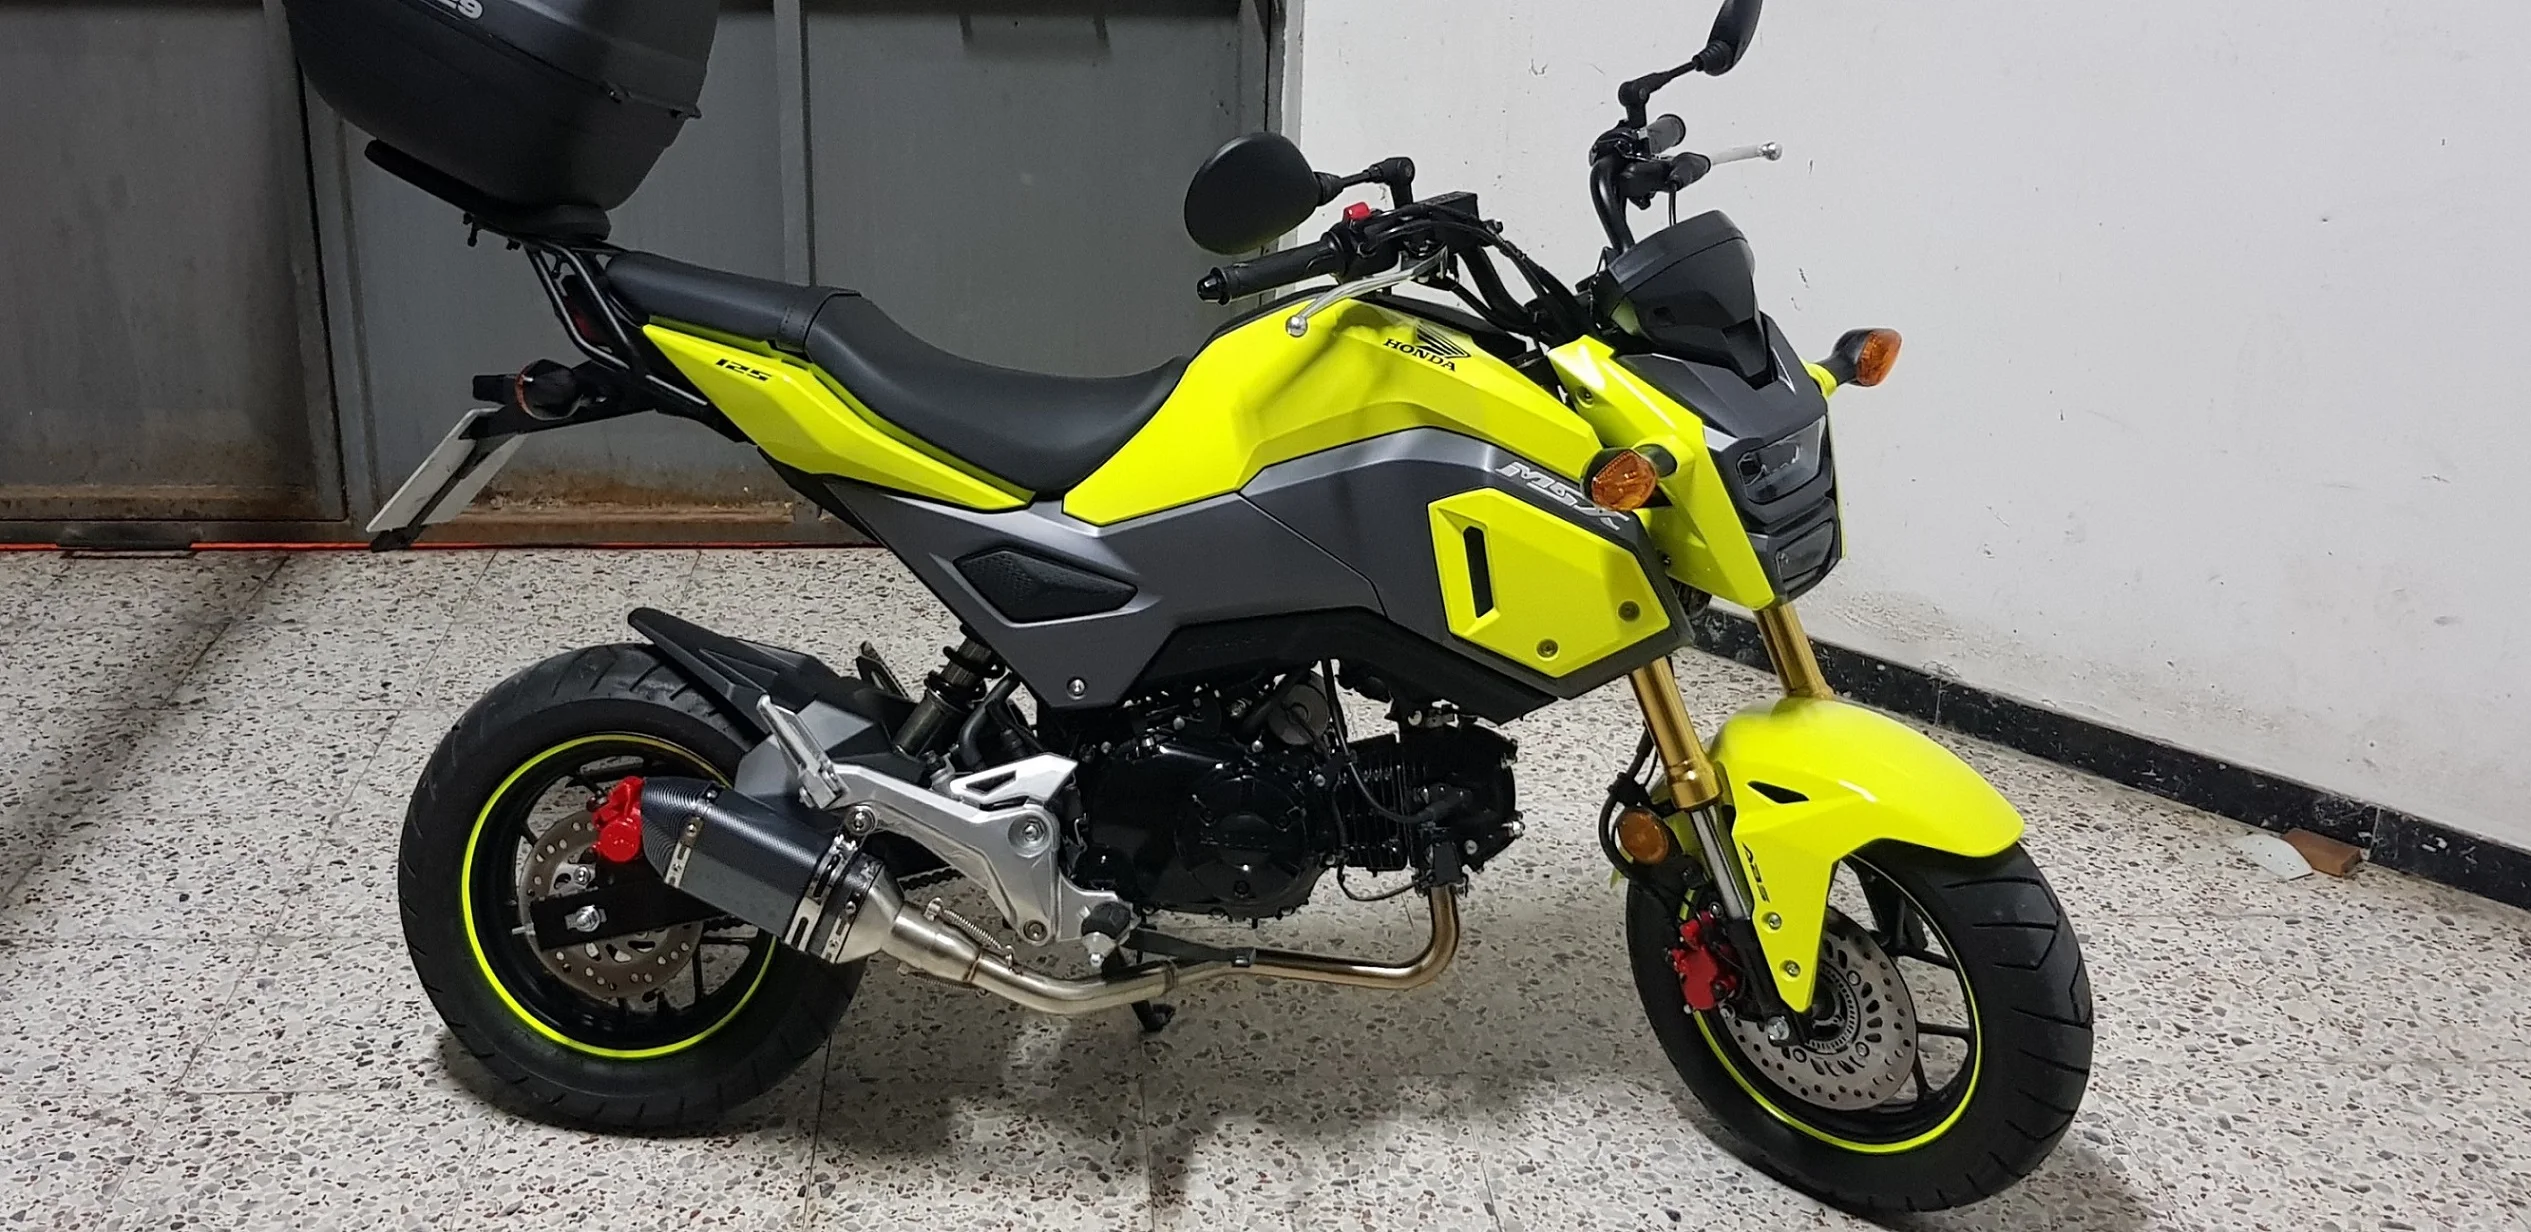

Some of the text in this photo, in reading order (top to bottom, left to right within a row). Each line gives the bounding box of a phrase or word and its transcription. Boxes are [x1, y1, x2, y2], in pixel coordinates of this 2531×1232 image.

[715, 358, 772, 382] 125
[1383, 338, 1456, 372] HONDA
[1495, 461, 1630, 531] MSX
